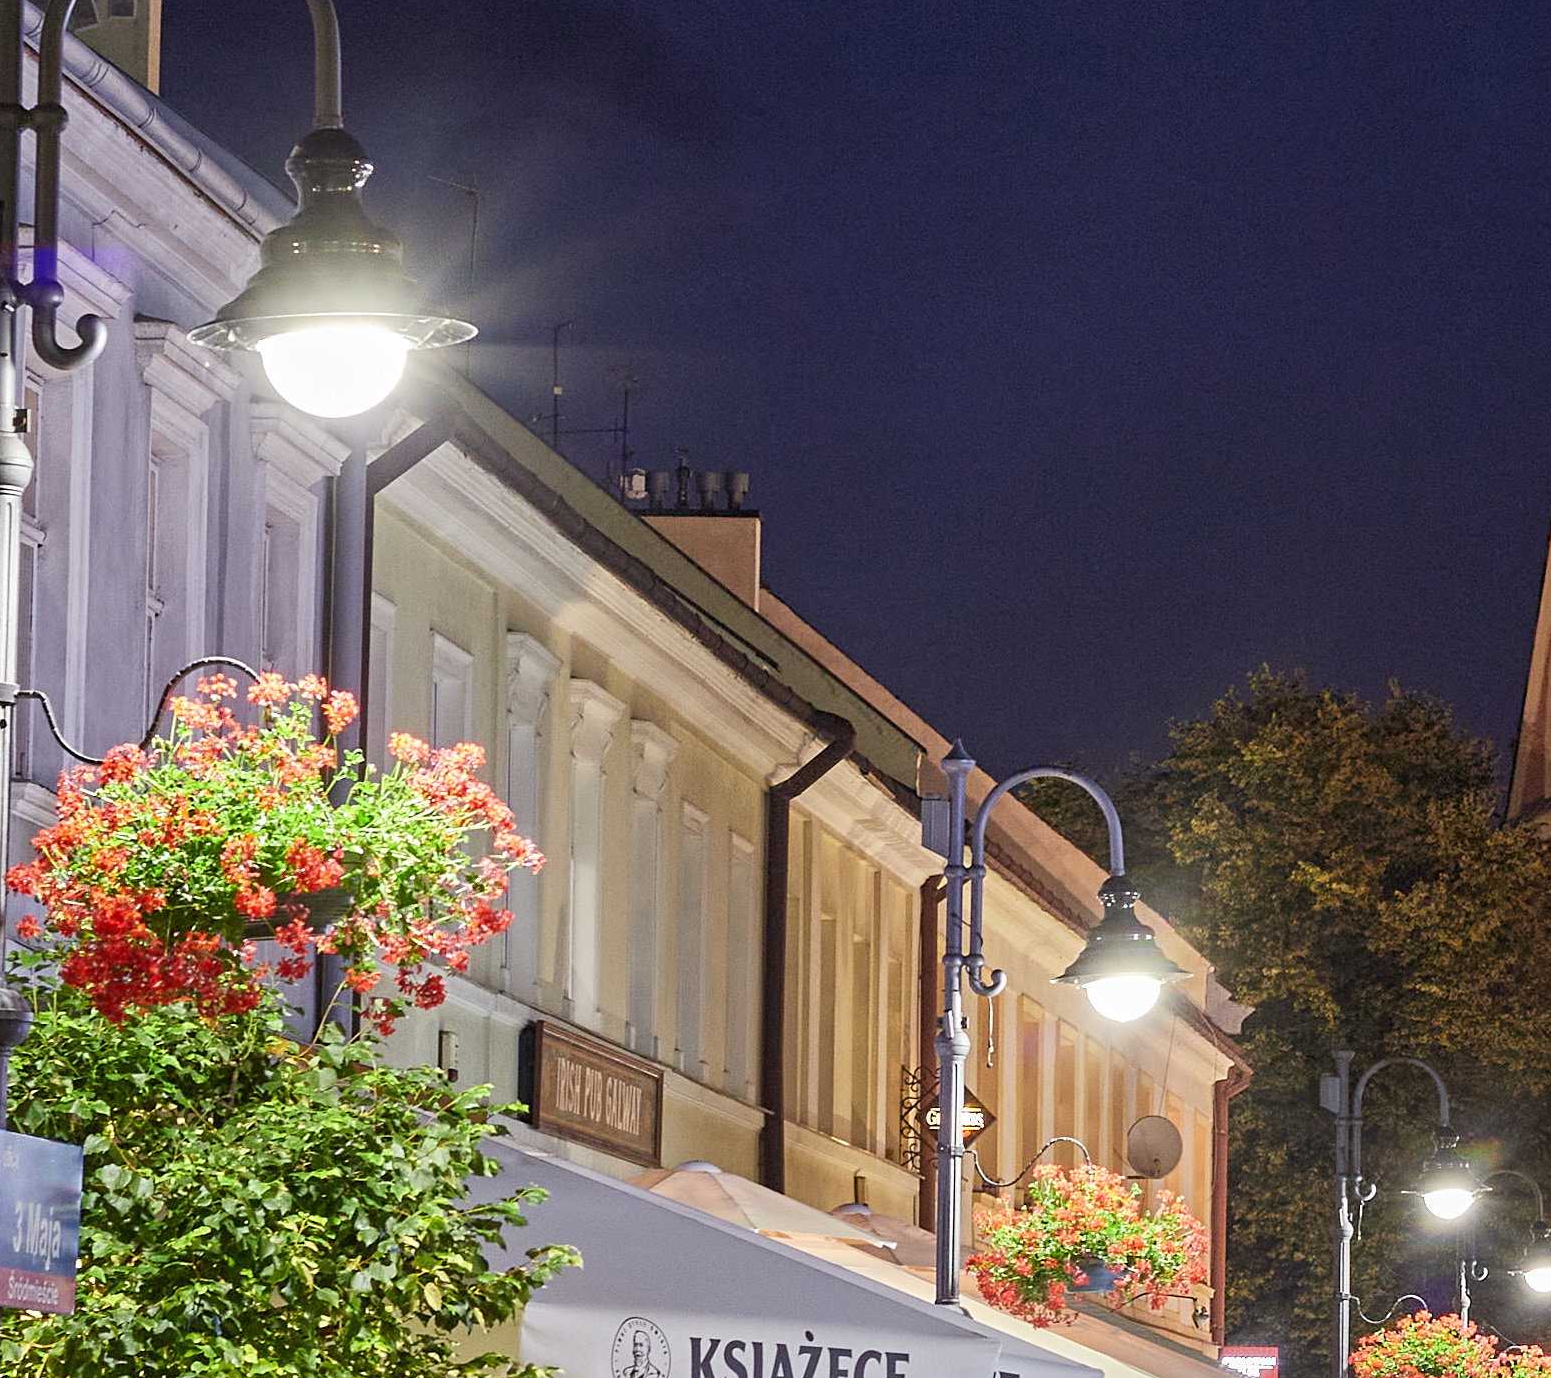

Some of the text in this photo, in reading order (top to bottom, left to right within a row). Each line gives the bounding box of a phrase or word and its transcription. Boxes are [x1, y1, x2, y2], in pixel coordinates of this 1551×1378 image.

[555, 1057, 642, 1136] IRISH PUB GALWAY
[12, 1203, 62, 1271] 3 Maja
[7, 1270, 59, 1306] Śródmieście
